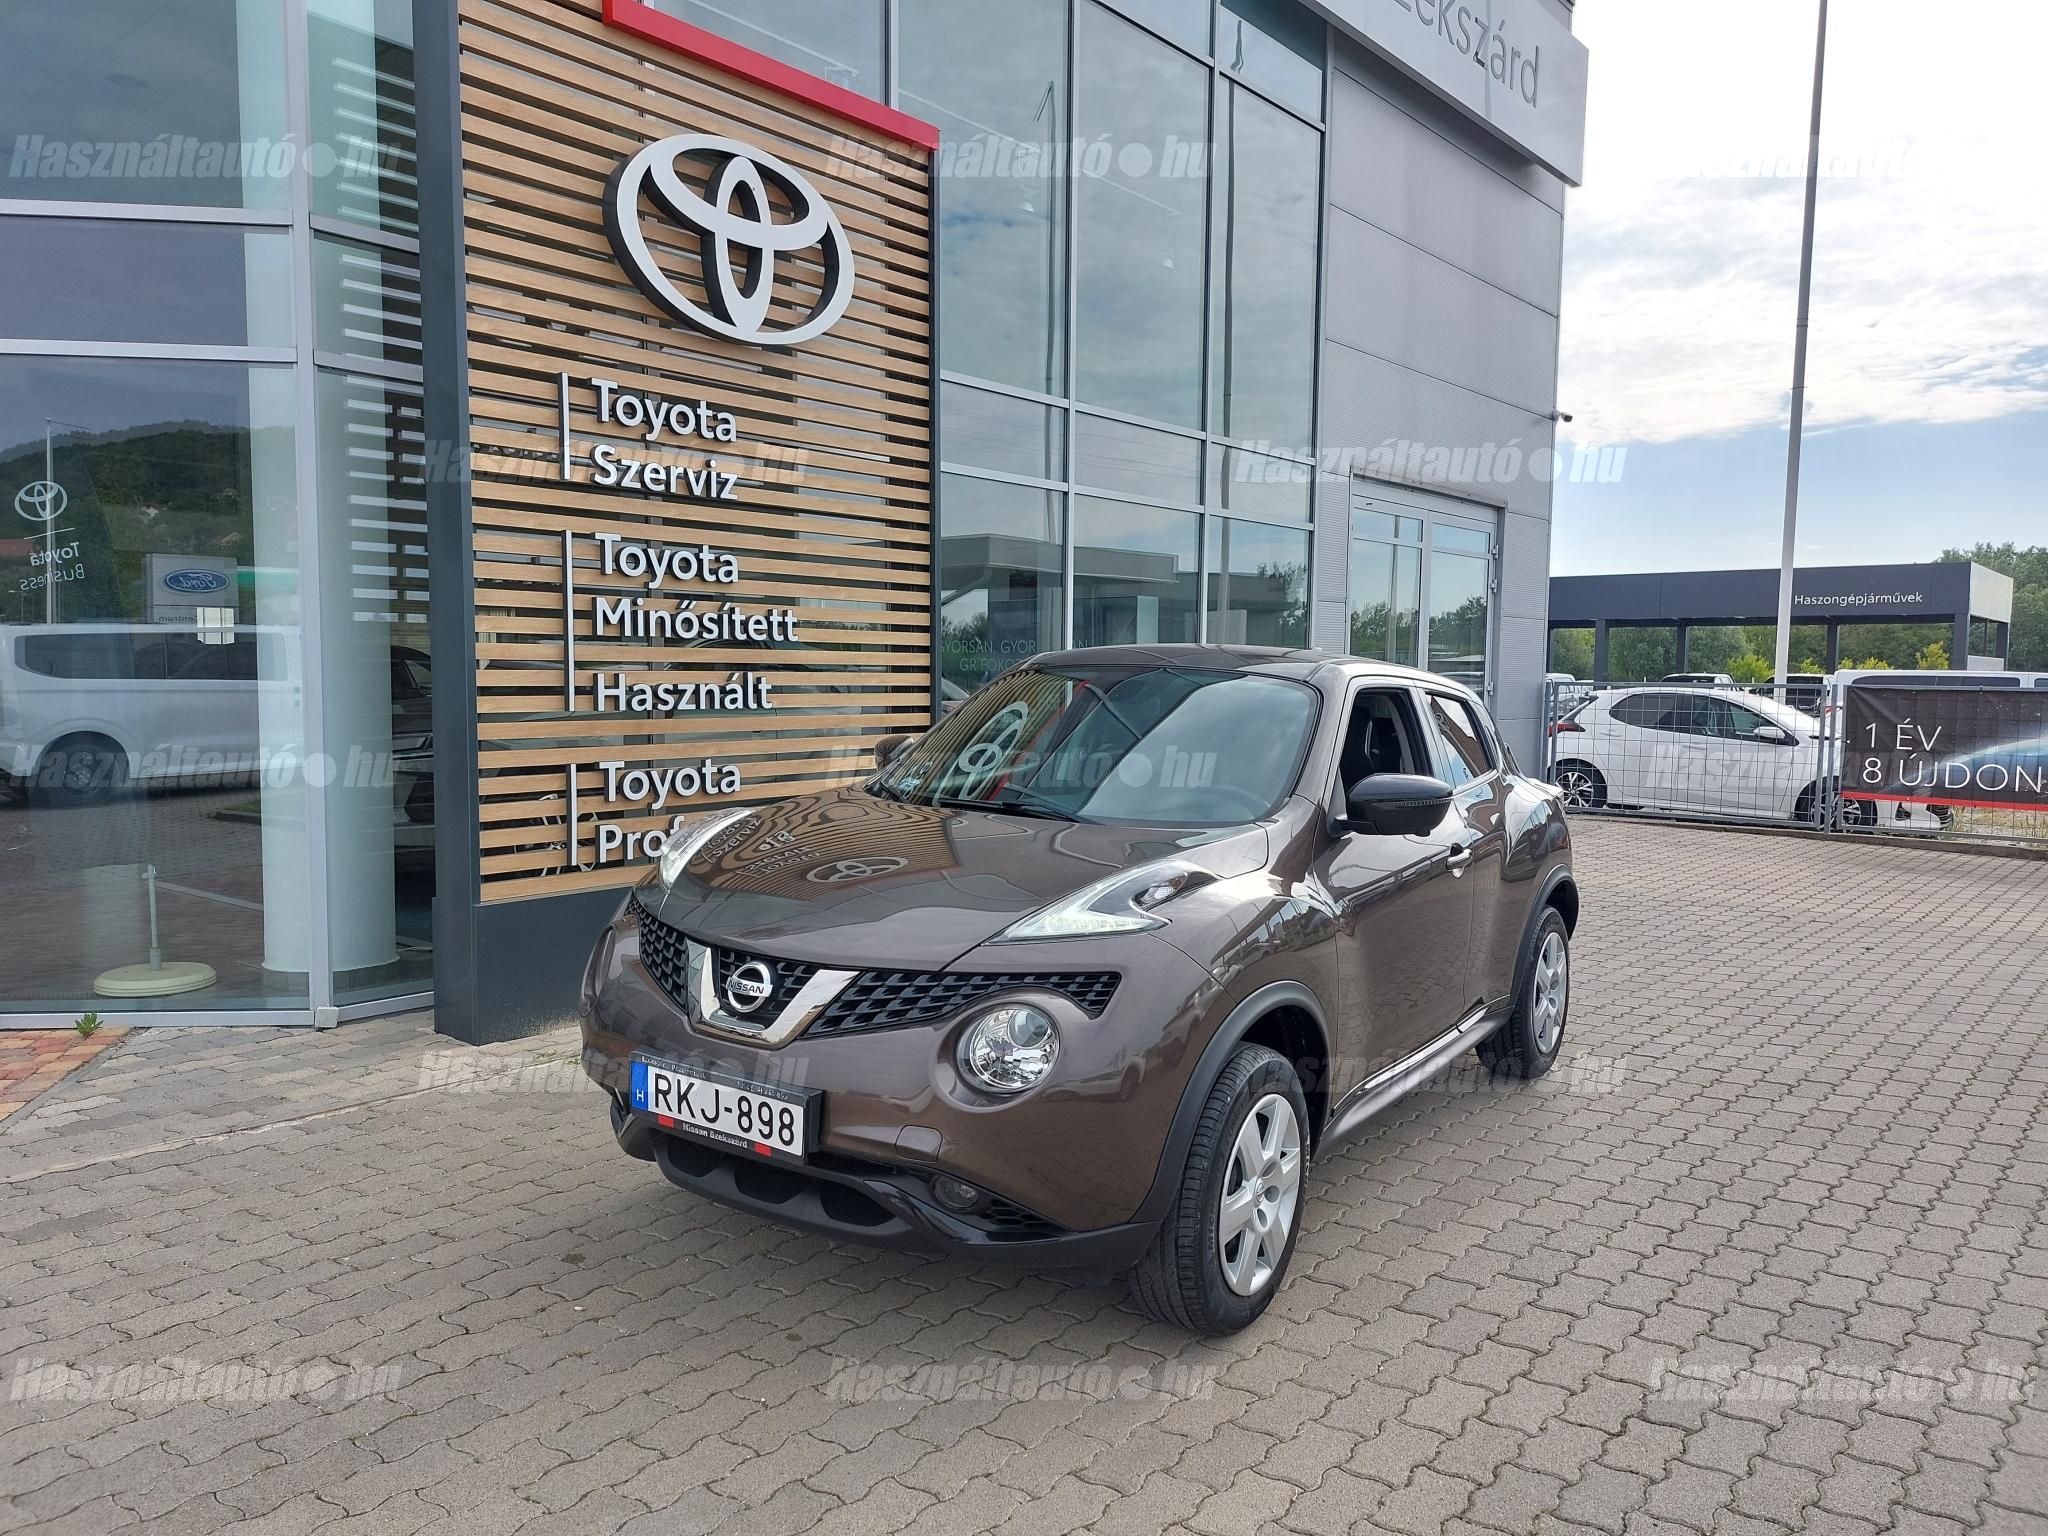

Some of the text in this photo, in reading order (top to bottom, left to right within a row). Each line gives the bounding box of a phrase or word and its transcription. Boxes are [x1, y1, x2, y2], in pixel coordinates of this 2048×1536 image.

[1395, 0, 1540, 108] ekszárd
[590, 377, 738, 442] Toyota
[593, 445, 738, 500] Szerviz
[594, 532, 740, 588] Toyota
[594, 597, 799, 642] Minősített
[1794, 591, 1923, 607] Haszongépjárművek
[595, 671, 773, 712] Használt
[1865, 717, 1942, 751] 1 ÉV
[597, 759, 741, 810] Toyota
[1862, 752, 2042, 793] 8 ÚJDON
[729, 978, 765, 995] NISSAN
[636, 1088, 646, 1103] H
[653, 1072, 795, 1147] RKJ-898
[682, 1122, 708, 1138] Nissan
